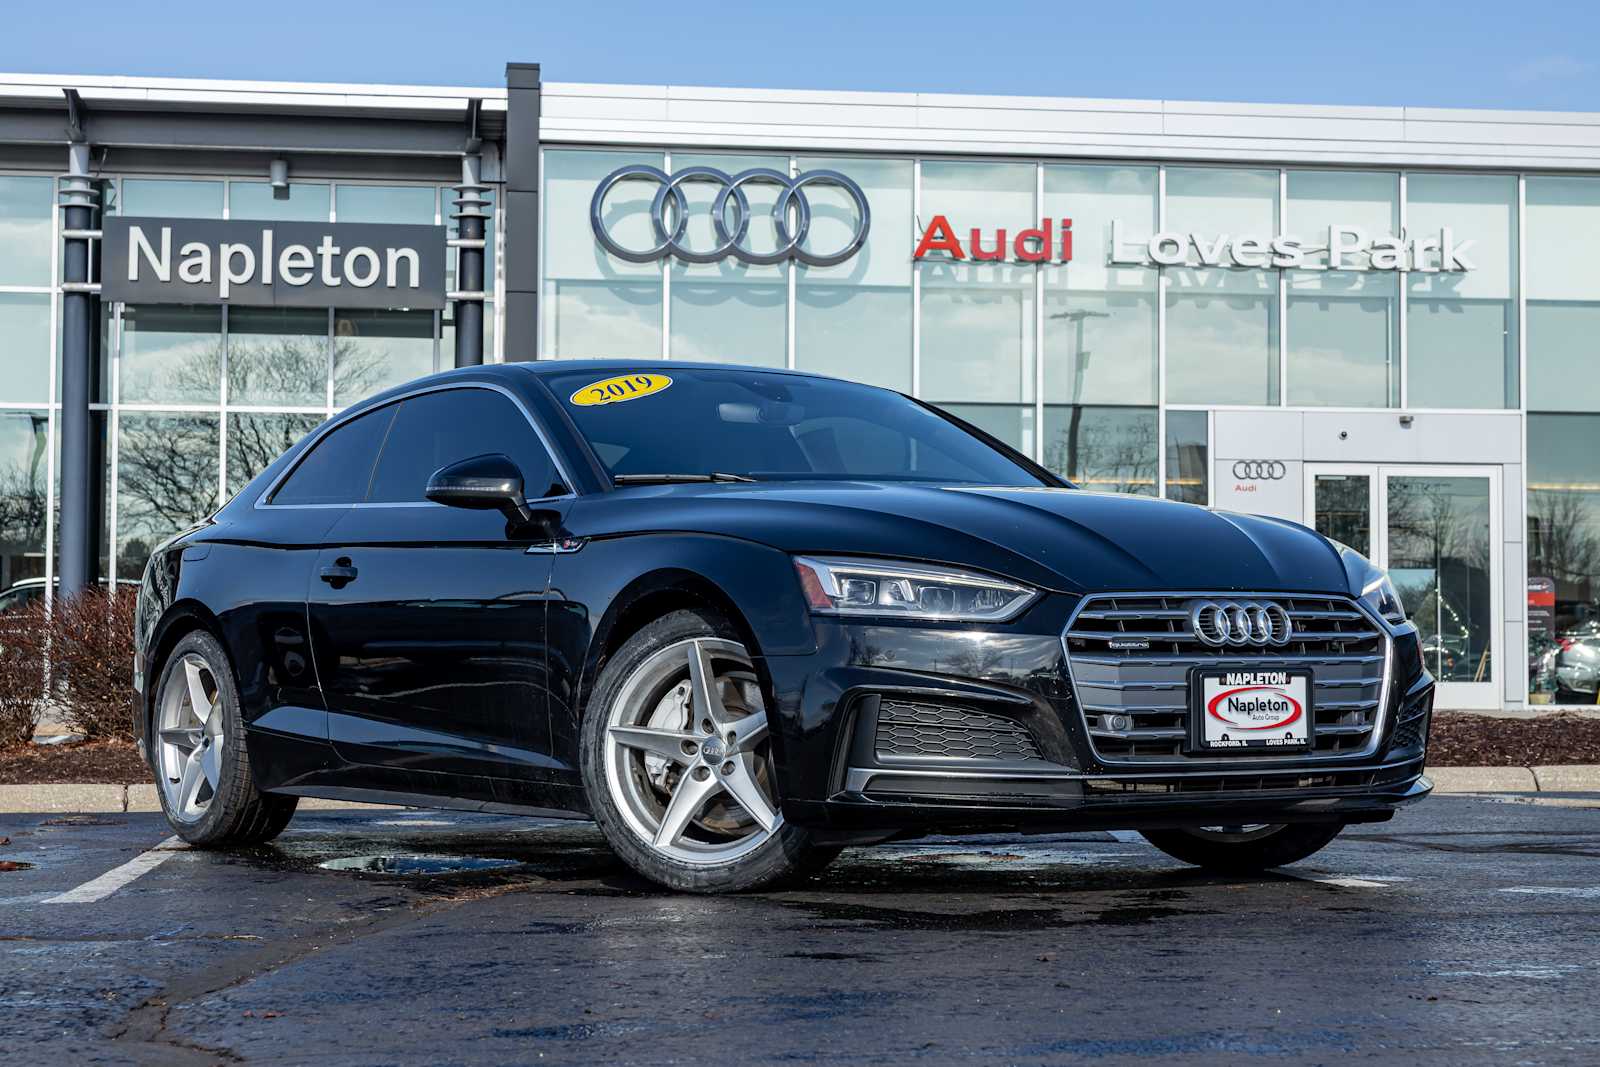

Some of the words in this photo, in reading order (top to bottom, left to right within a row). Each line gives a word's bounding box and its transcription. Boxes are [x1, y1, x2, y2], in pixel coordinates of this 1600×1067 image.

[913, 215, 1073, 262] Audi
[1111, 219, 1305, 269] Loves
[1328, 224, 1476, 272] Park
[128, 226, 420, 299] Napleton
[590, 376, 652, 401] 2019
[1234, 484, 1257, 492] Audi
[1226, 672, 1287, 685] NAPLETON
[1228, 697, 1288, 715] Napleton
[1266, 738, 1283, 746] LOVES
